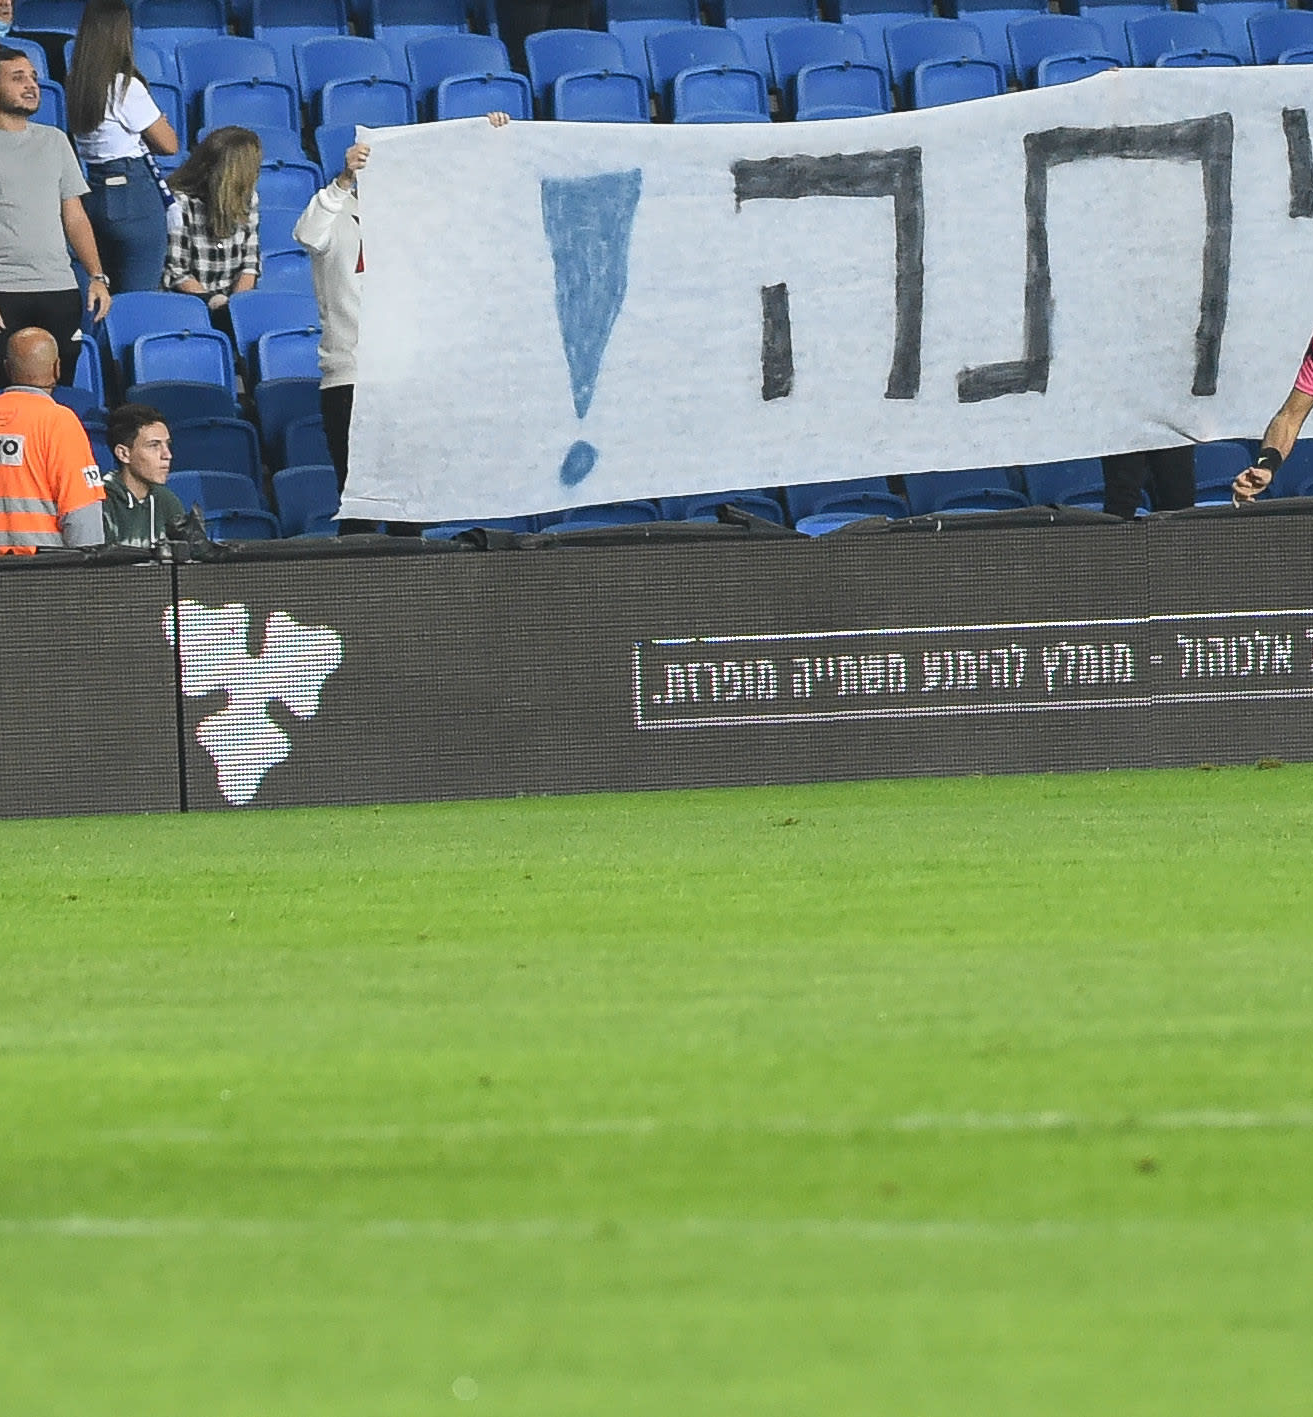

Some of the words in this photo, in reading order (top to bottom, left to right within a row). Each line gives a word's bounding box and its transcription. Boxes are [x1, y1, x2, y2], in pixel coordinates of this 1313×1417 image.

[920, 643, 1028, 693] להימנע
[1042, 641, 1136, 695] מומלץ
[1177, 630, 1292, 679] אלכוהול
